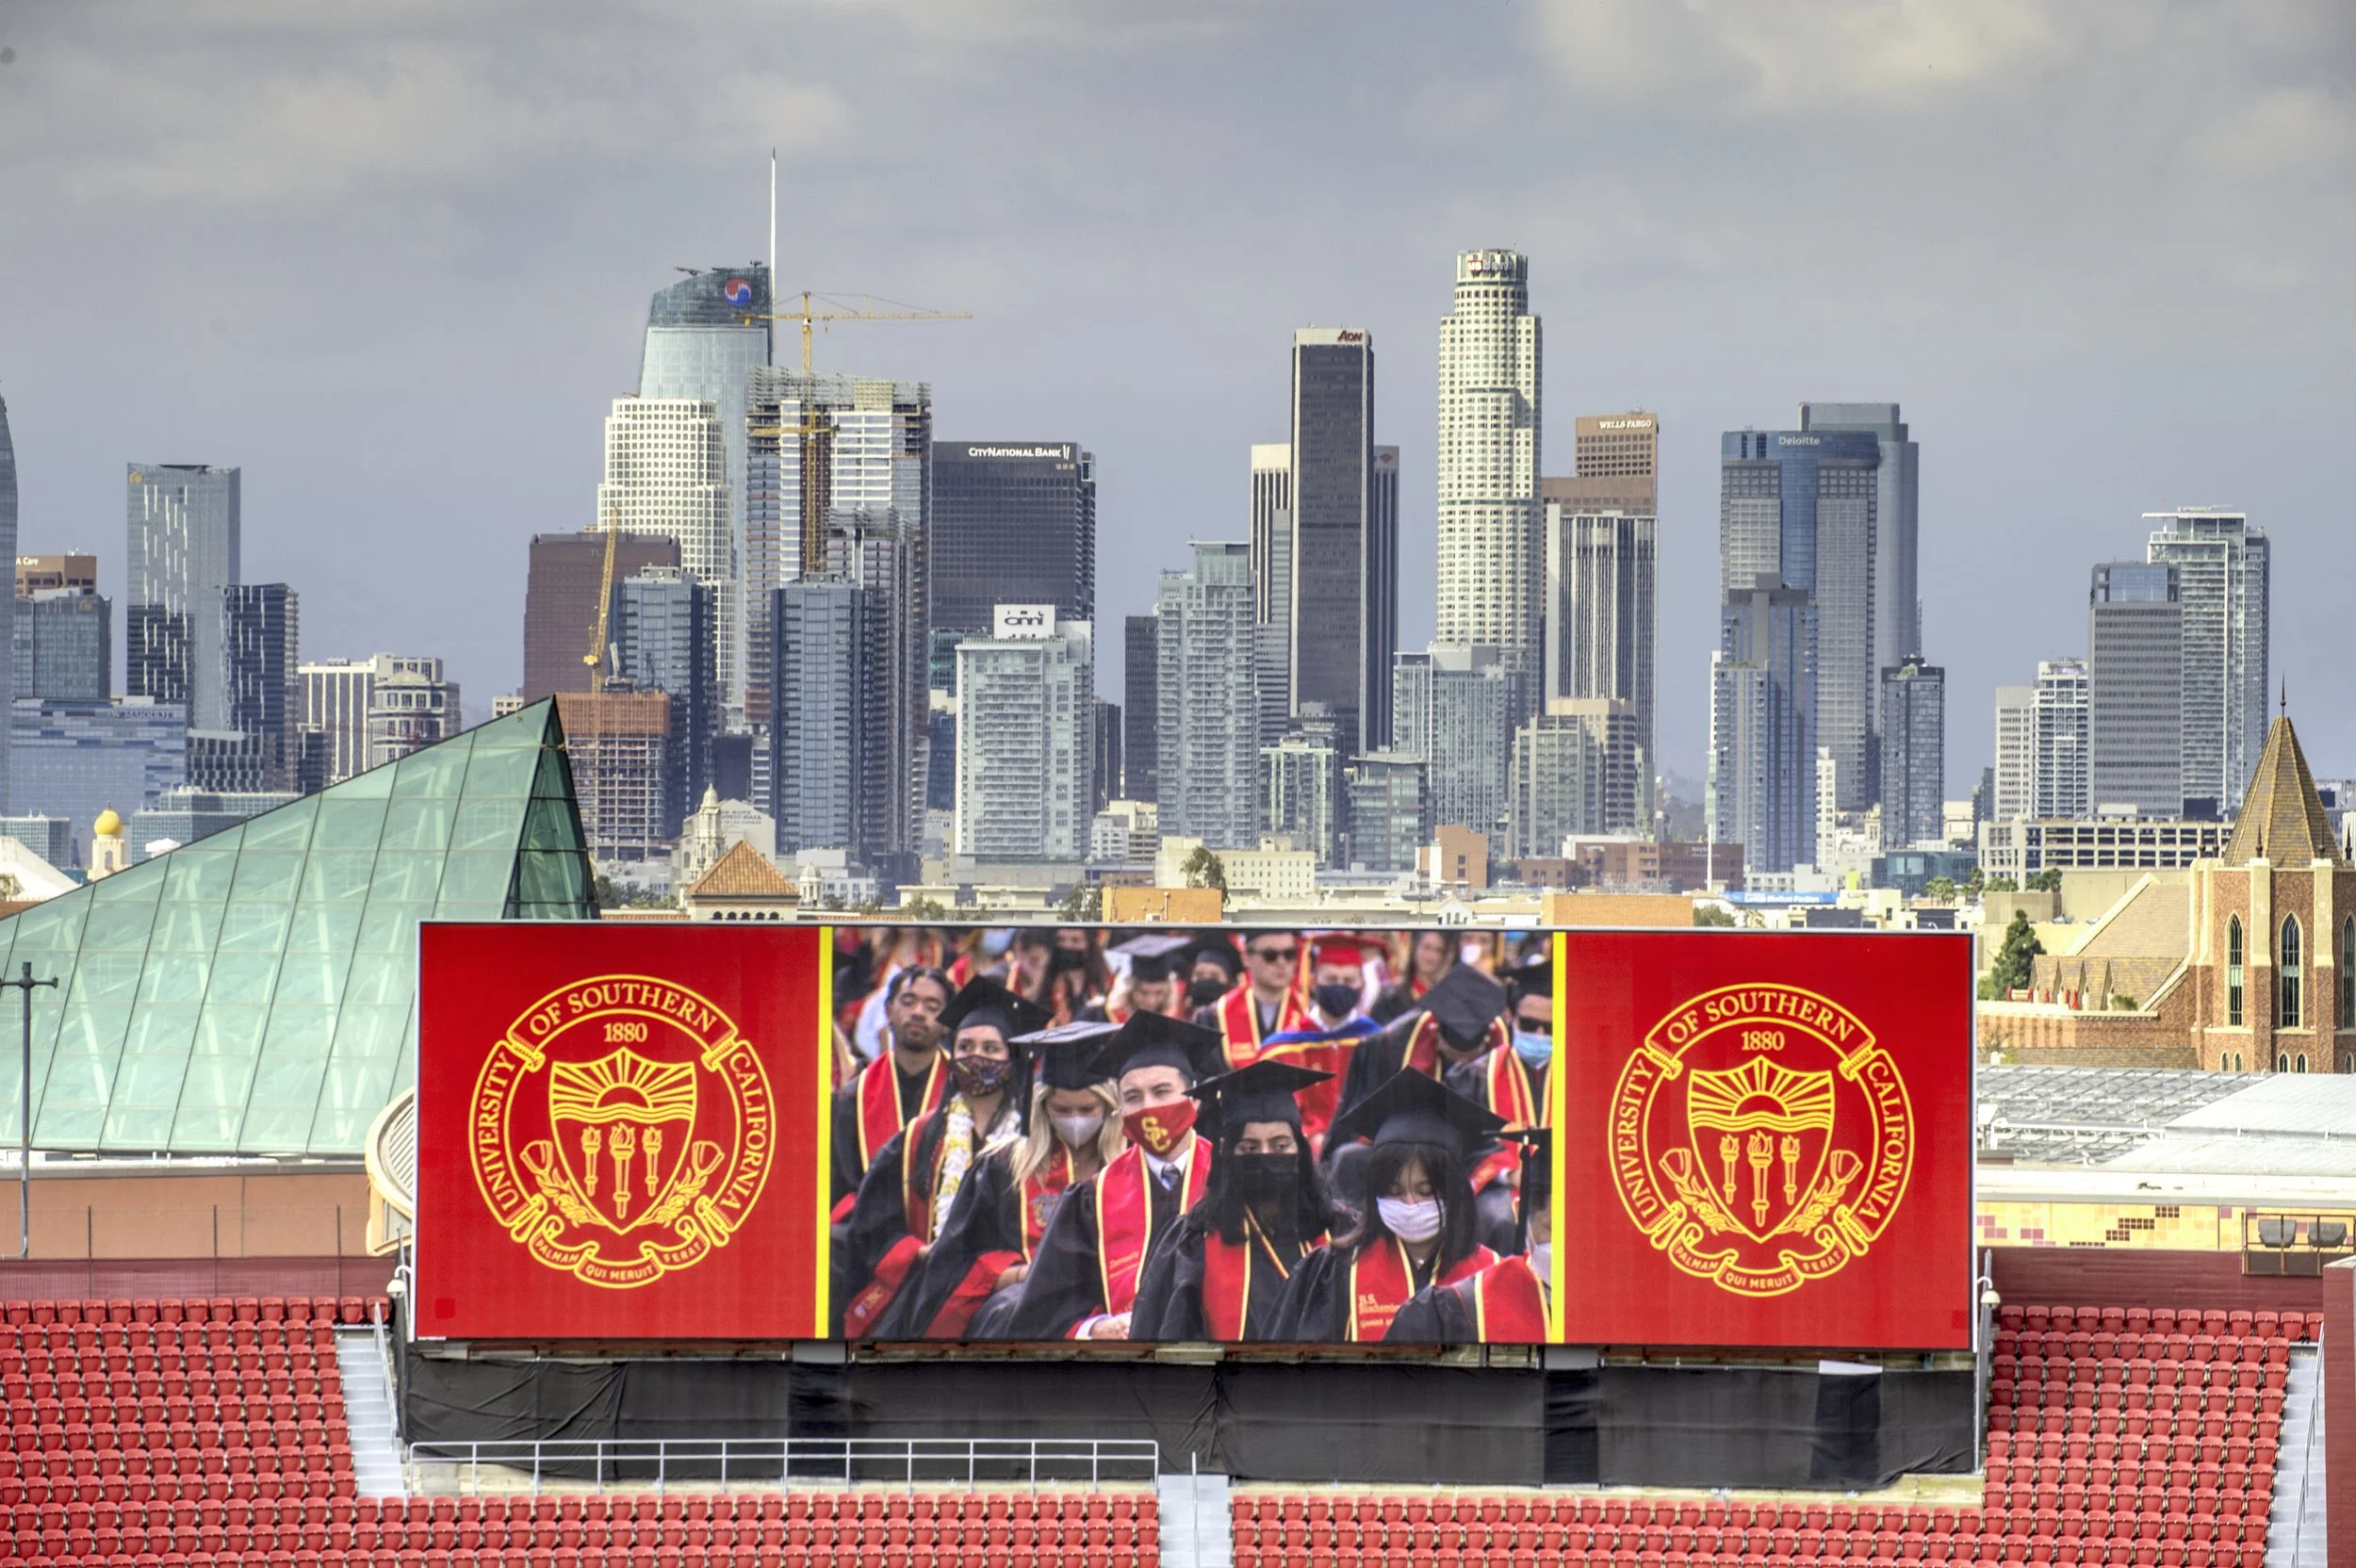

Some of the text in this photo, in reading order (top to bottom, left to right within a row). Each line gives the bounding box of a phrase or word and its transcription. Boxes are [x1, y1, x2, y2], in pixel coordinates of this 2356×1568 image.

[1626, 419, 1651, 428] FARGO
[1779, 436, 1820, 445] Deloitte
[1035, 447, 1061, 457] BANK
[23, 557, 39, 565] Care
[603, 1022, 647, 1042] 1880
[1741, 1031, 1785, 1051] 1880
[478, 983, 766, 1211] UNIVERSITY OF SOUTHERN CALIFORNIA
[1617, 991, 1906, 1219] UNIVERSITY OF SOUTHERN CALIFORNIA
[535, 1238, 701, 1281] PALMAM QUI MERUIT FERAT
[1675, 1246, 1841, 1289] PALMAM QUI MERUIT FERAT
